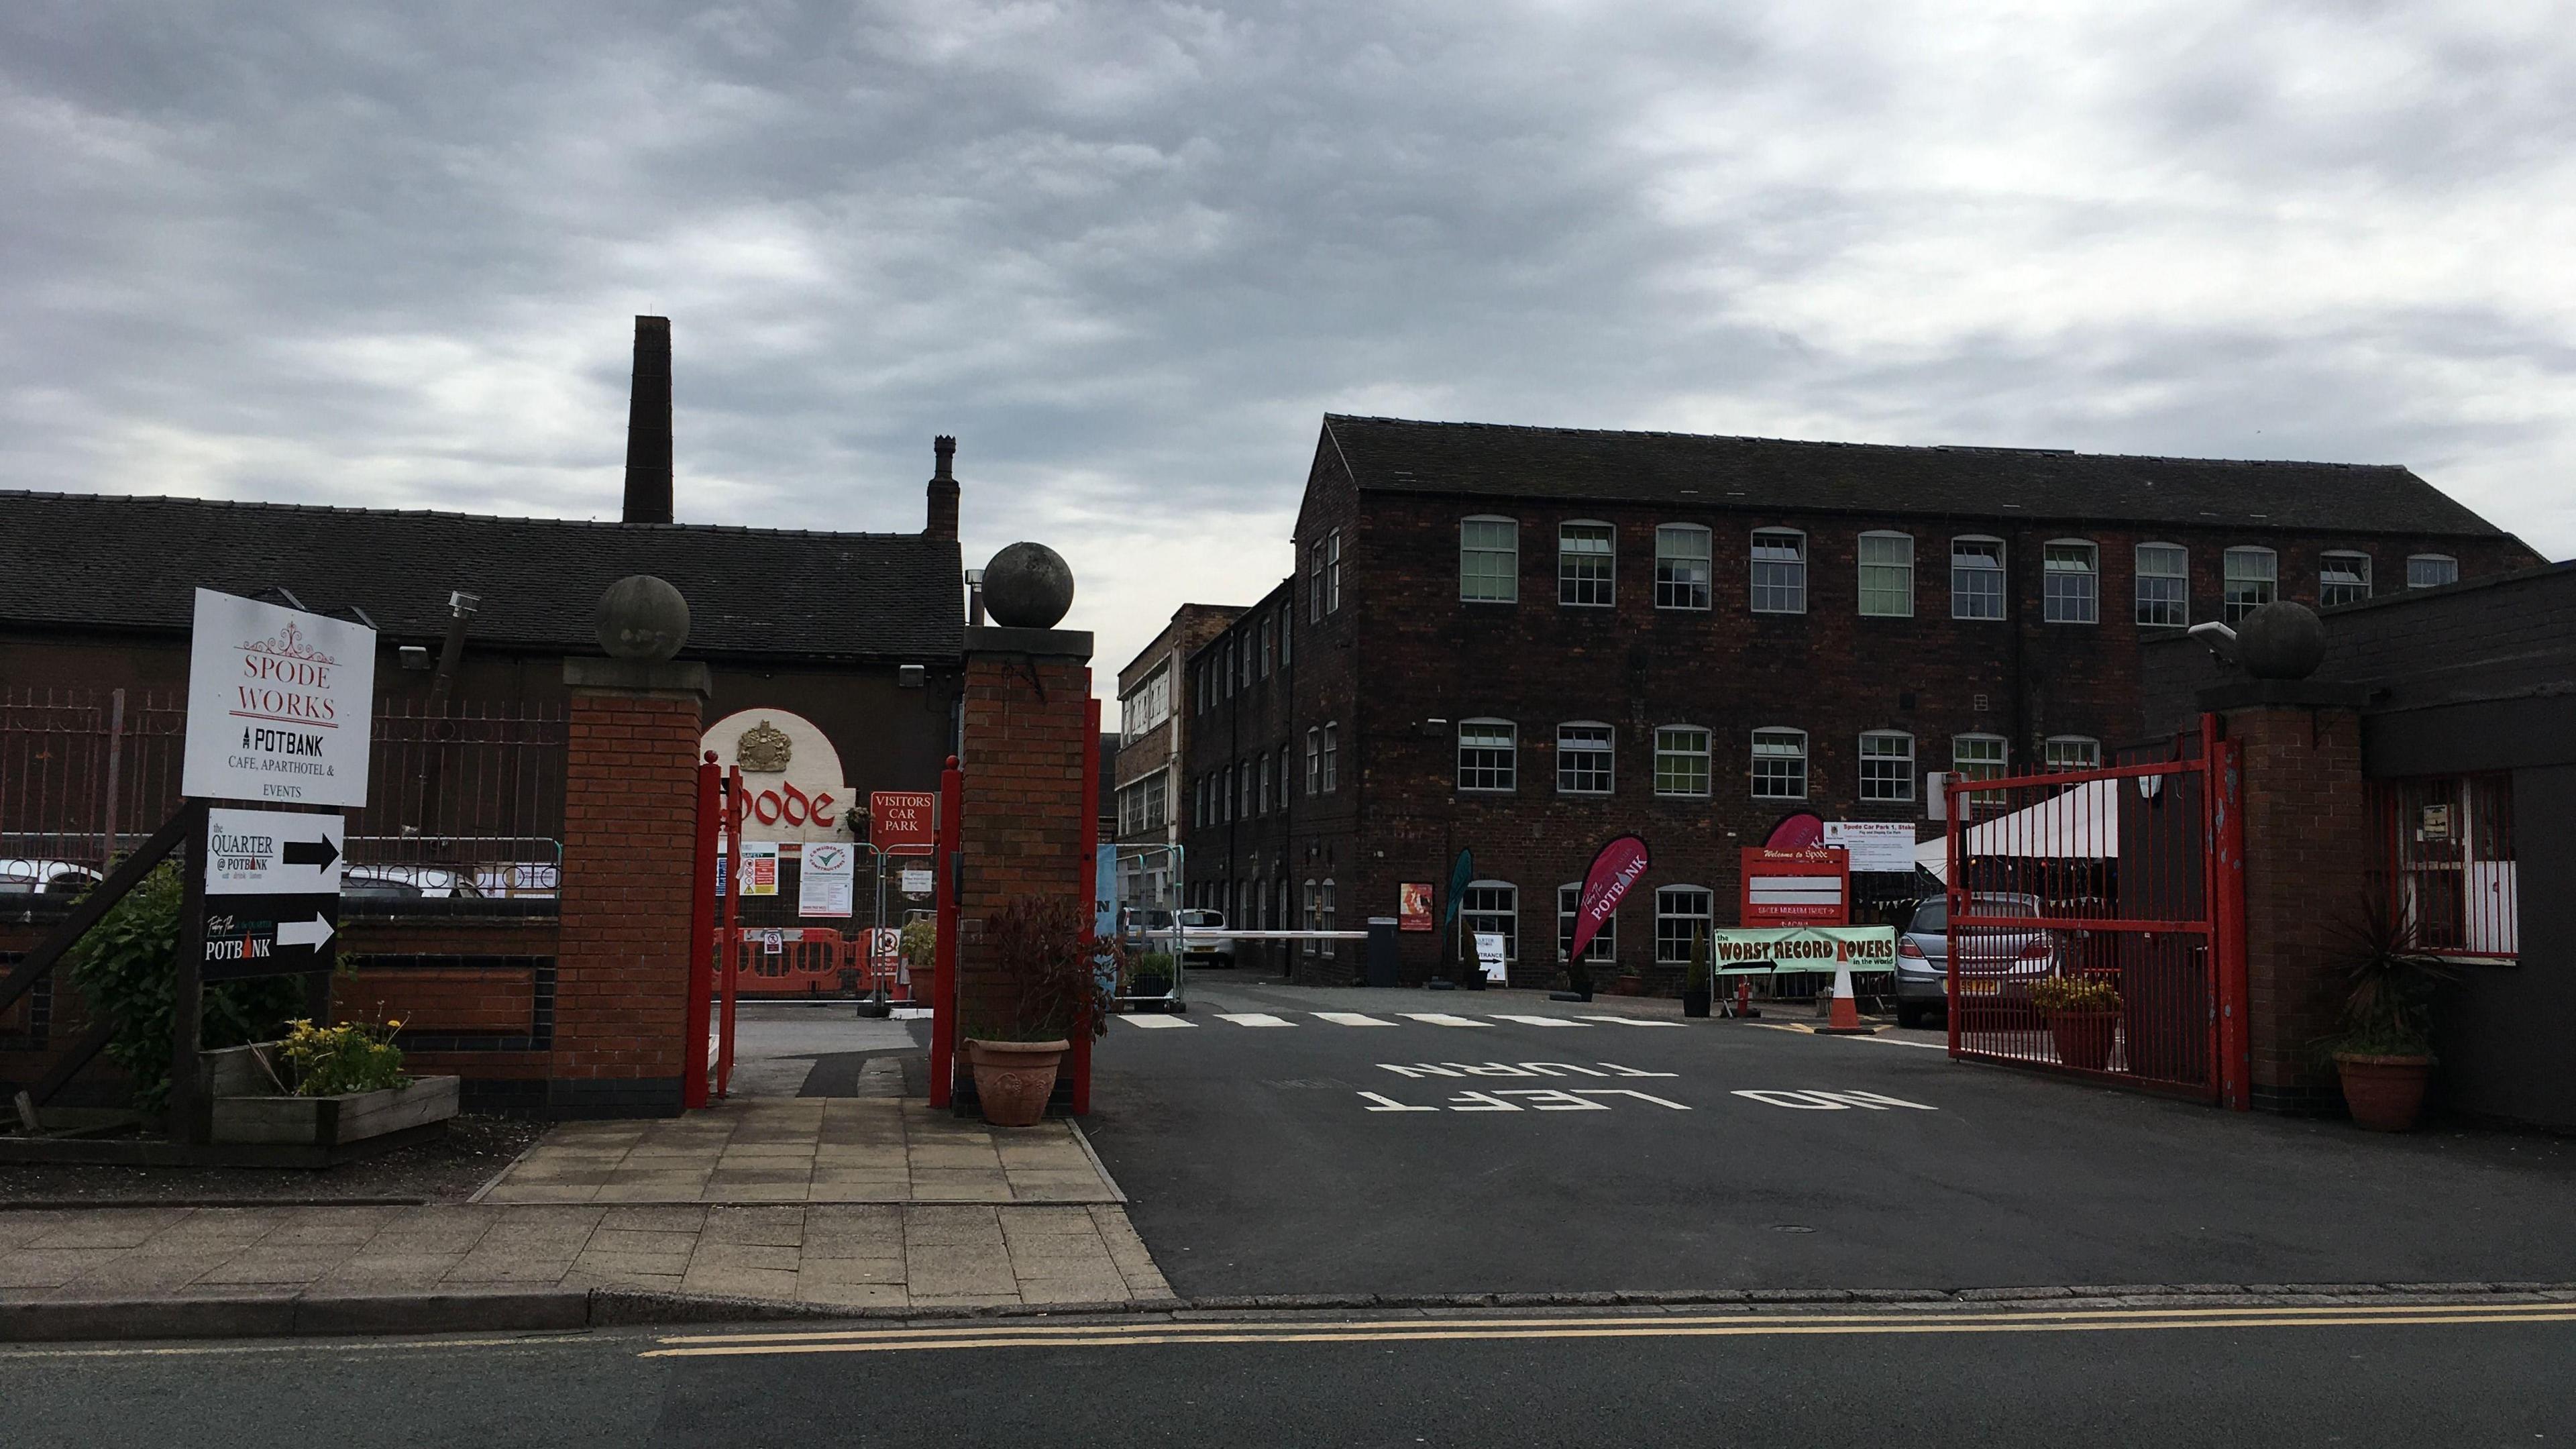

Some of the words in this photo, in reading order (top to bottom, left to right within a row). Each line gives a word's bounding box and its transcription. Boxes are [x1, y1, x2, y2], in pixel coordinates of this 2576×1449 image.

[244, 654, 330, 690] SPODE
[238, 686, 335, 720] WORKS
[254, 728, 323, 757] POTBANK
[229, 755, 258, 771] CAFE,
[261, 761, 324, 775] APARTHOTEL
[327, 765, 334, 776] &
[263, 784, 301, 798] EVENTS
[875, 796, 930, 807] VISITORS
[889, 808, 916, 818] CAR
[213, 824, 223, 833] the
[885, 820, 919, 831] PARK
[212, 835, 273, 857] QUARTER
[1764, 849, 1793, 858] Welcome
[1717, 942, 1771, 961] WORST
[1774, 941, 1833, 959] RECORD
[1846, 940, 1892, 958] OVERS
[1375, 1062, 1679, 1077] TURN
[1357, 1089, 1693, 1112] LEFT
[1730, 1089, 1939, 1111] NO
